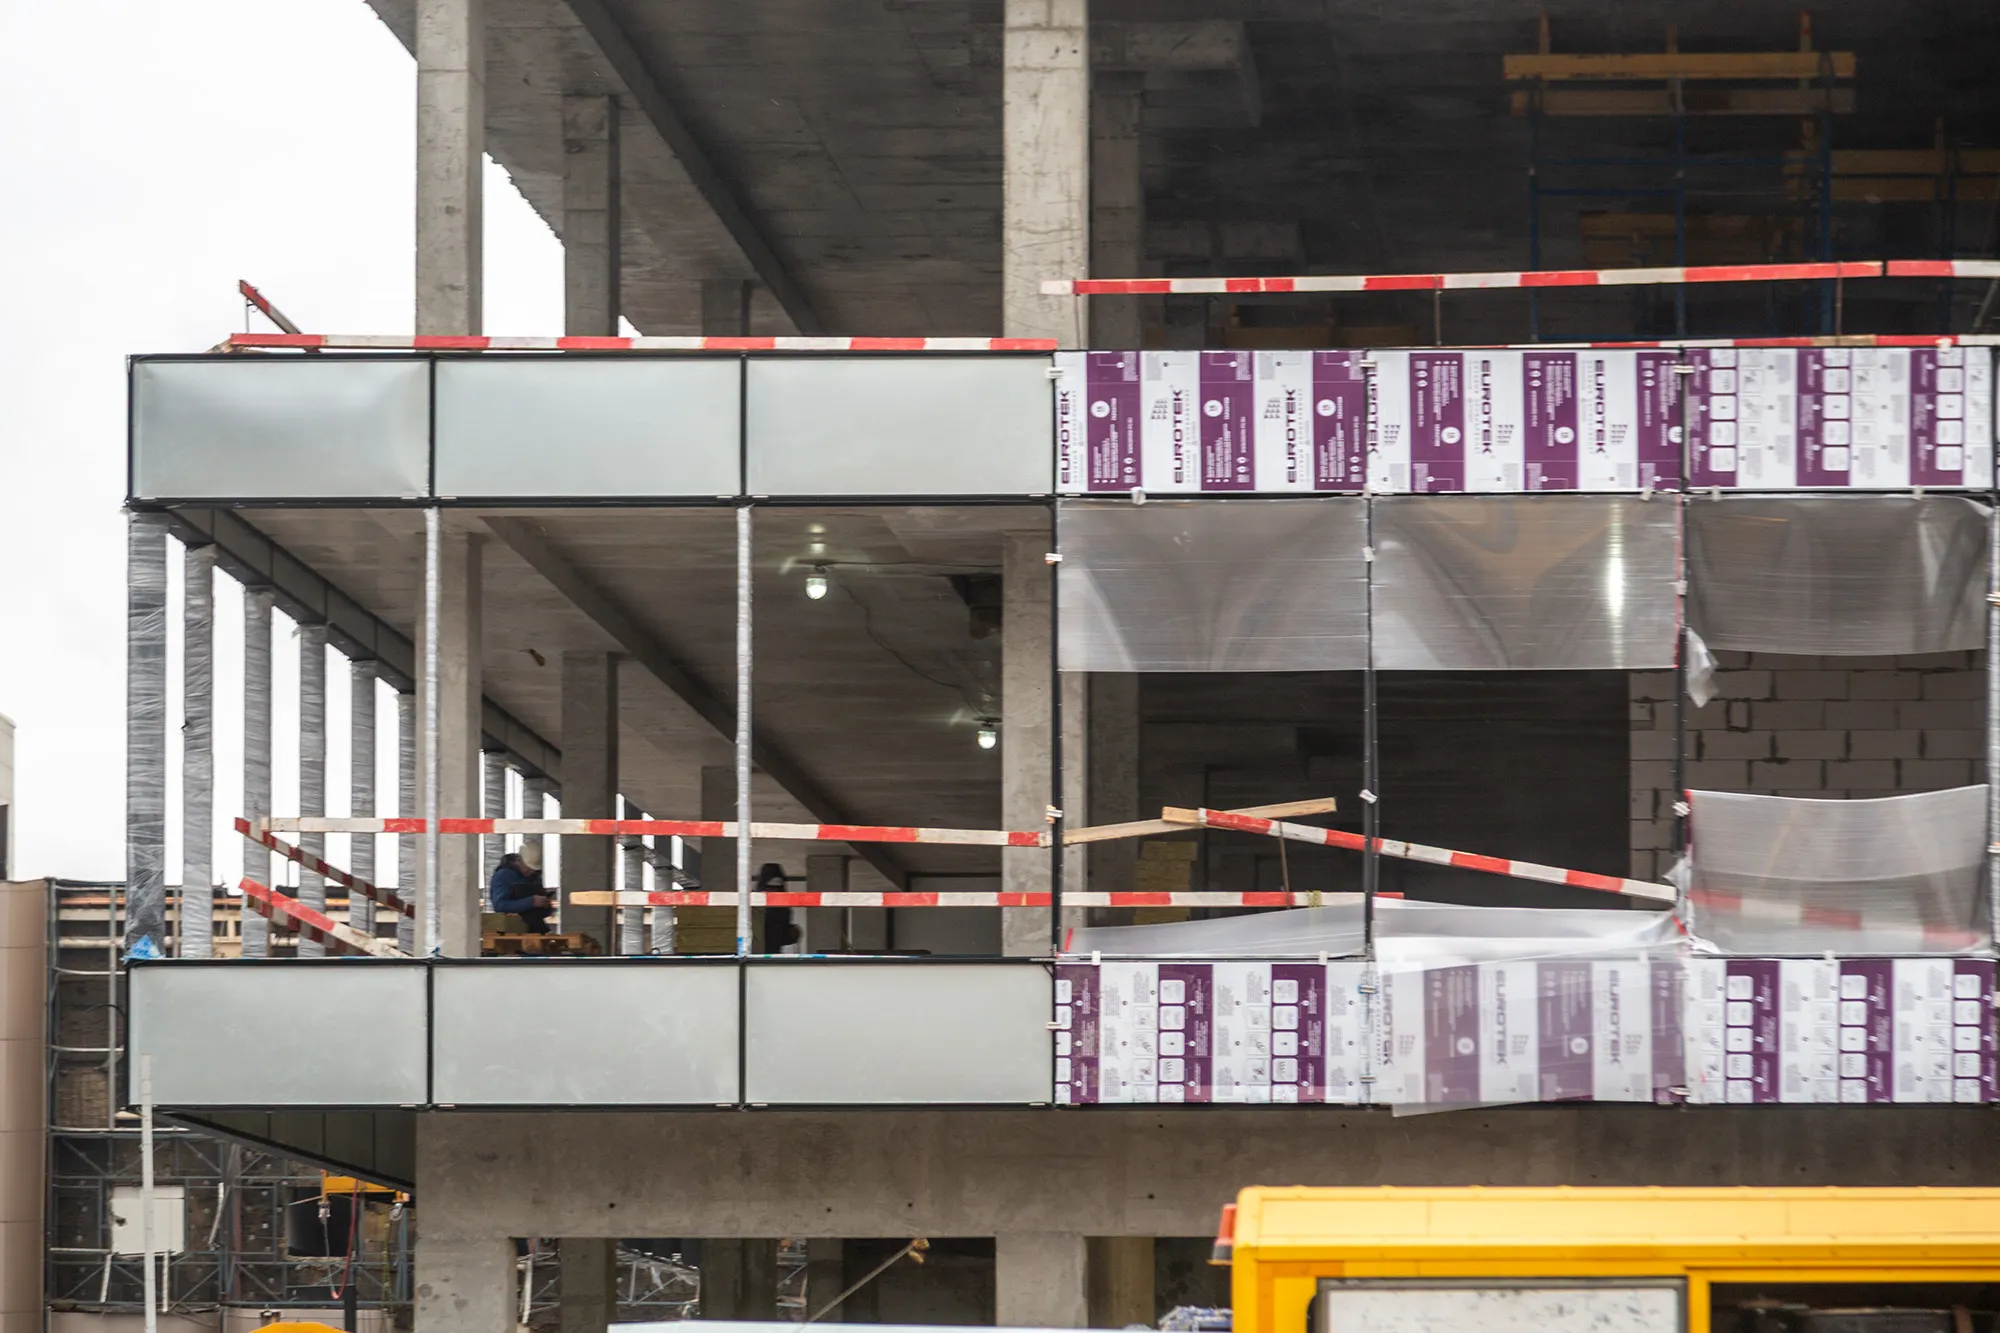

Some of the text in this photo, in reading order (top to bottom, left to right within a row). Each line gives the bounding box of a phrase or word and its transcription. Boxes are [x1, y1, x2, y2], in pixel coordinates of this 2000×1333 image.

[1060, 390, 1070, 484] EUROTEK
[1173, 389, 1183, 484] EUROTEK
[1286, 389, 1296, 483] EUROTEK
[1481, 360, 1492, 454] EUROTEK
[1594, 359, 1605, 454] EUROTEK
